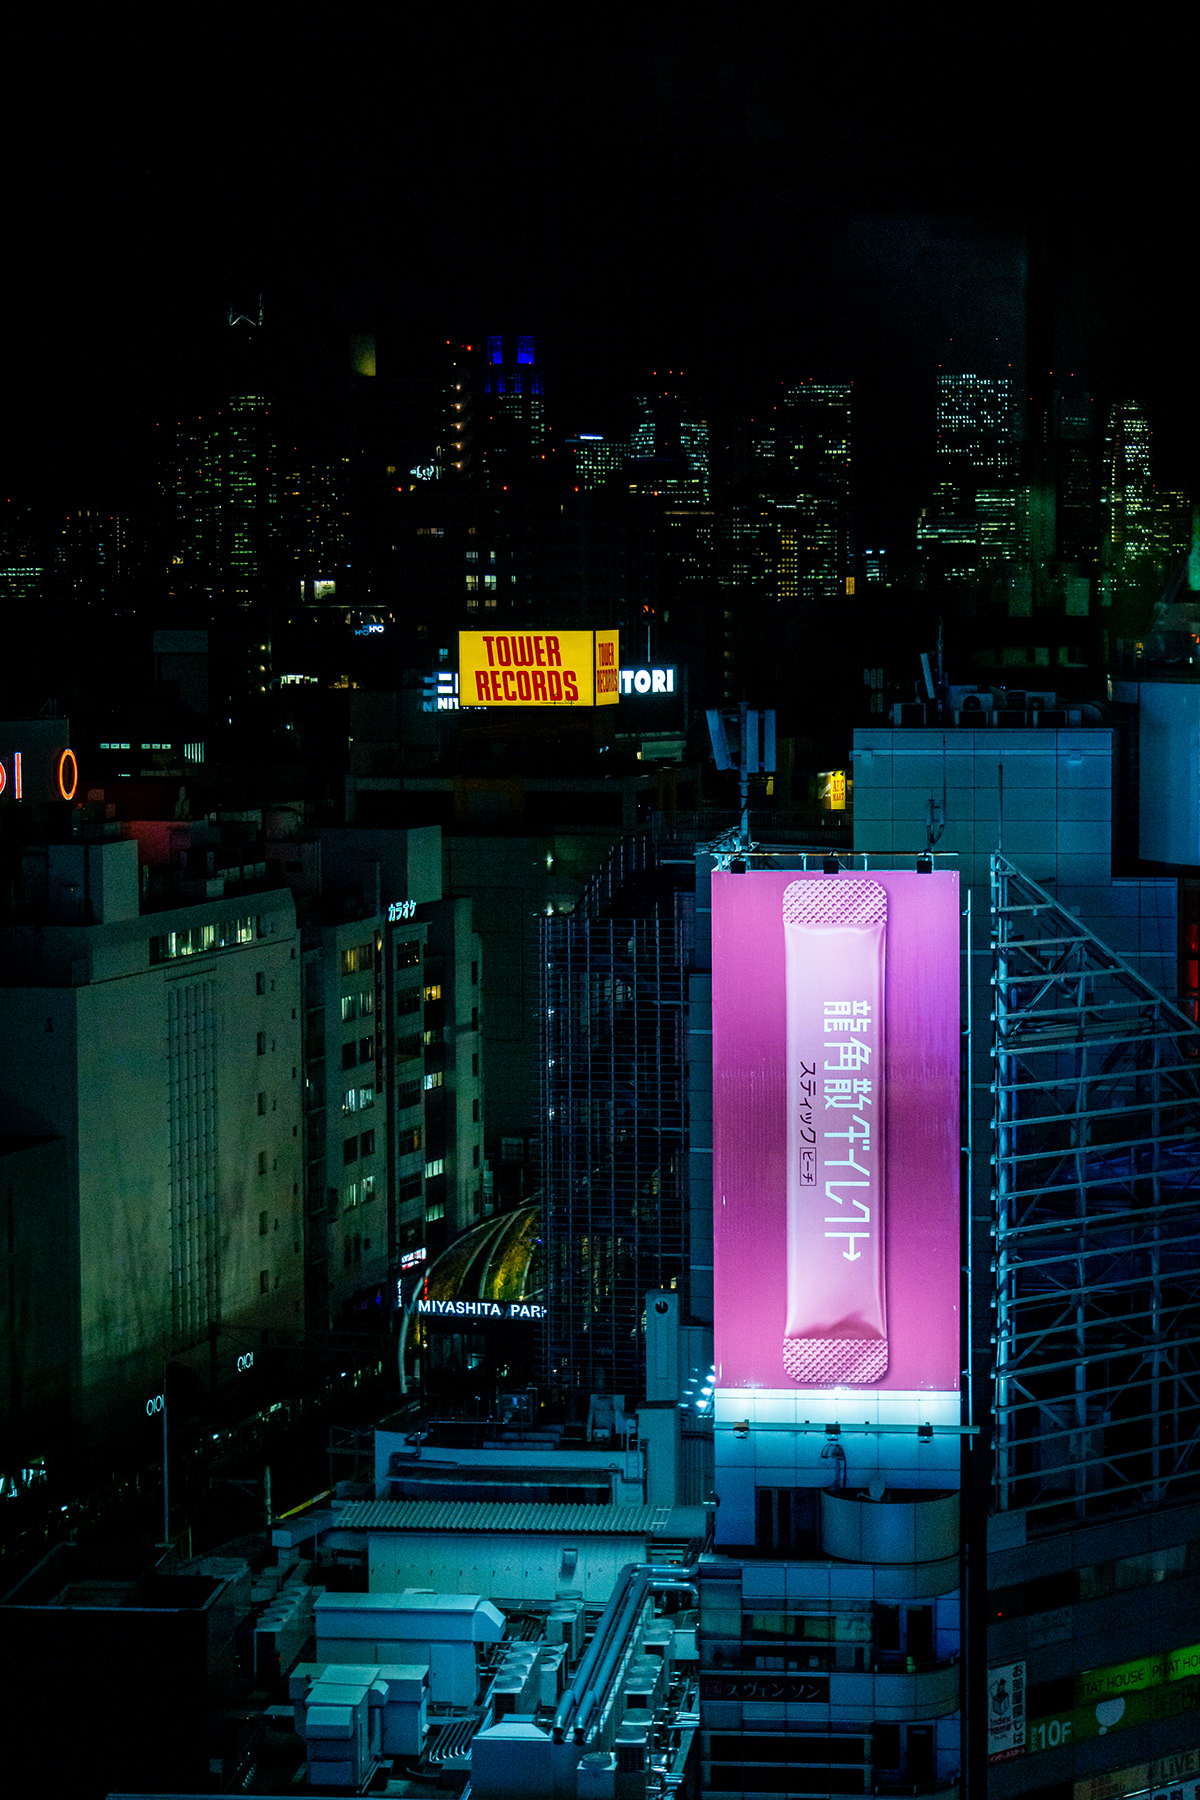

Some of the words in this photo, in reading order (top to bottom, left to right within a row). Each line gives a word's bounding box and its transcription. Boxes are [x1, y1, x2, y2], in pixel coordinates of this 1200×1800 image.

[482, 635, 562, 667] TOWER
[598, 642, 614, 666] TOWER
[475, 670, 579, 702] RECORDS
[597, 668, 618, 694] RECORDS
[619, 669, 674, 693] ITORI
[388, 899, 416, 922] カラオケ
[799, 1061, 817, 1144] スティック
[823, 1000, 872, 1262] 龍角散ダイレクト
[801, 1150, 815, 1184] ピーチ
[418, 1300, 501, 1316] MIYASHITA
[725, 1682, 820, 1699] スヴェンソン
[1106, 1668, 1145, 1689] HOUSE
[1037, 1720, 1071, 1749] 10F
